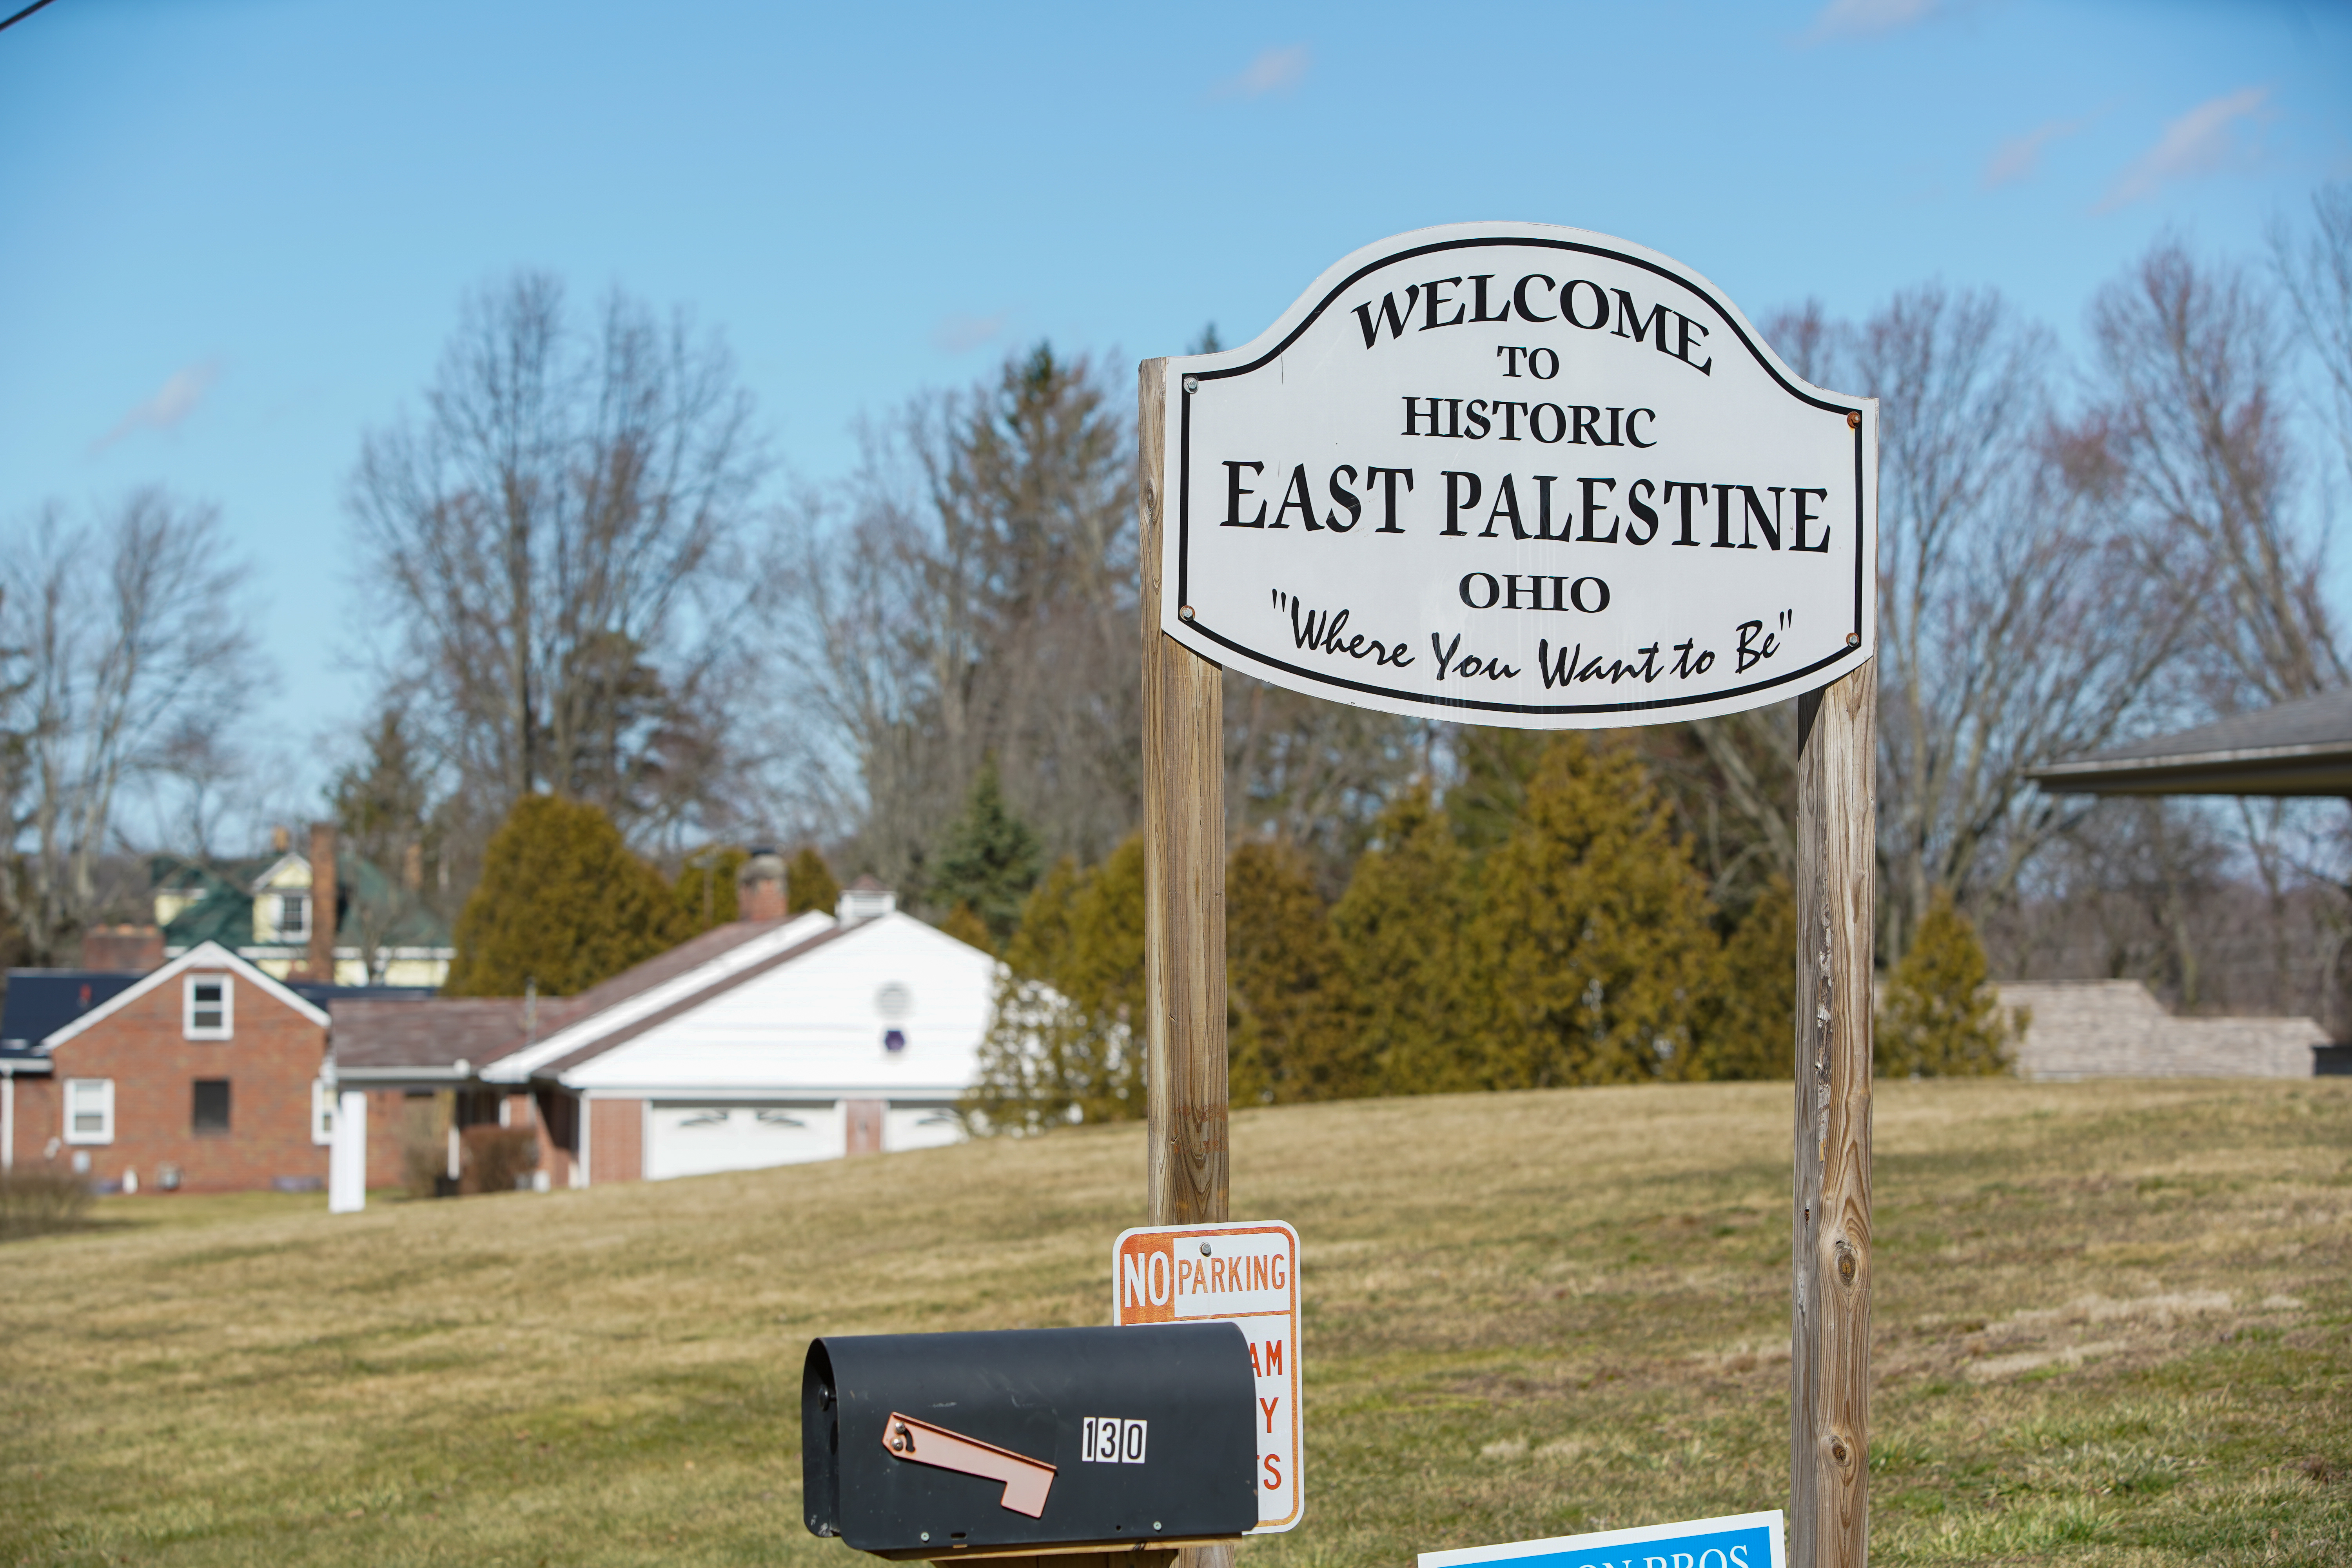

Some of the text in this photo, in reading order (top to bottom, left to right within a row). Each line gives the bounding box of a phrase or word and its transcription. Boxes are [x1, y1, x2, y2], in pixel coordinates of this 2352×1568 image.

[1350, 274, 1712, 377] WELCOME
[1497, 345, 1559, 379] TO
[1401, 396, 1657, 448] HISTORIC
[1220, 461, 1831, 553] EAST PALESTINE
[1459, 572, 1610, 613] OHIO
[1272, 588, 1792, 689] "Where You Want to Be"
[1124, 1250, 1285, 1308] NO PARKING
[1087, 1421, 1143, 1460] 130
